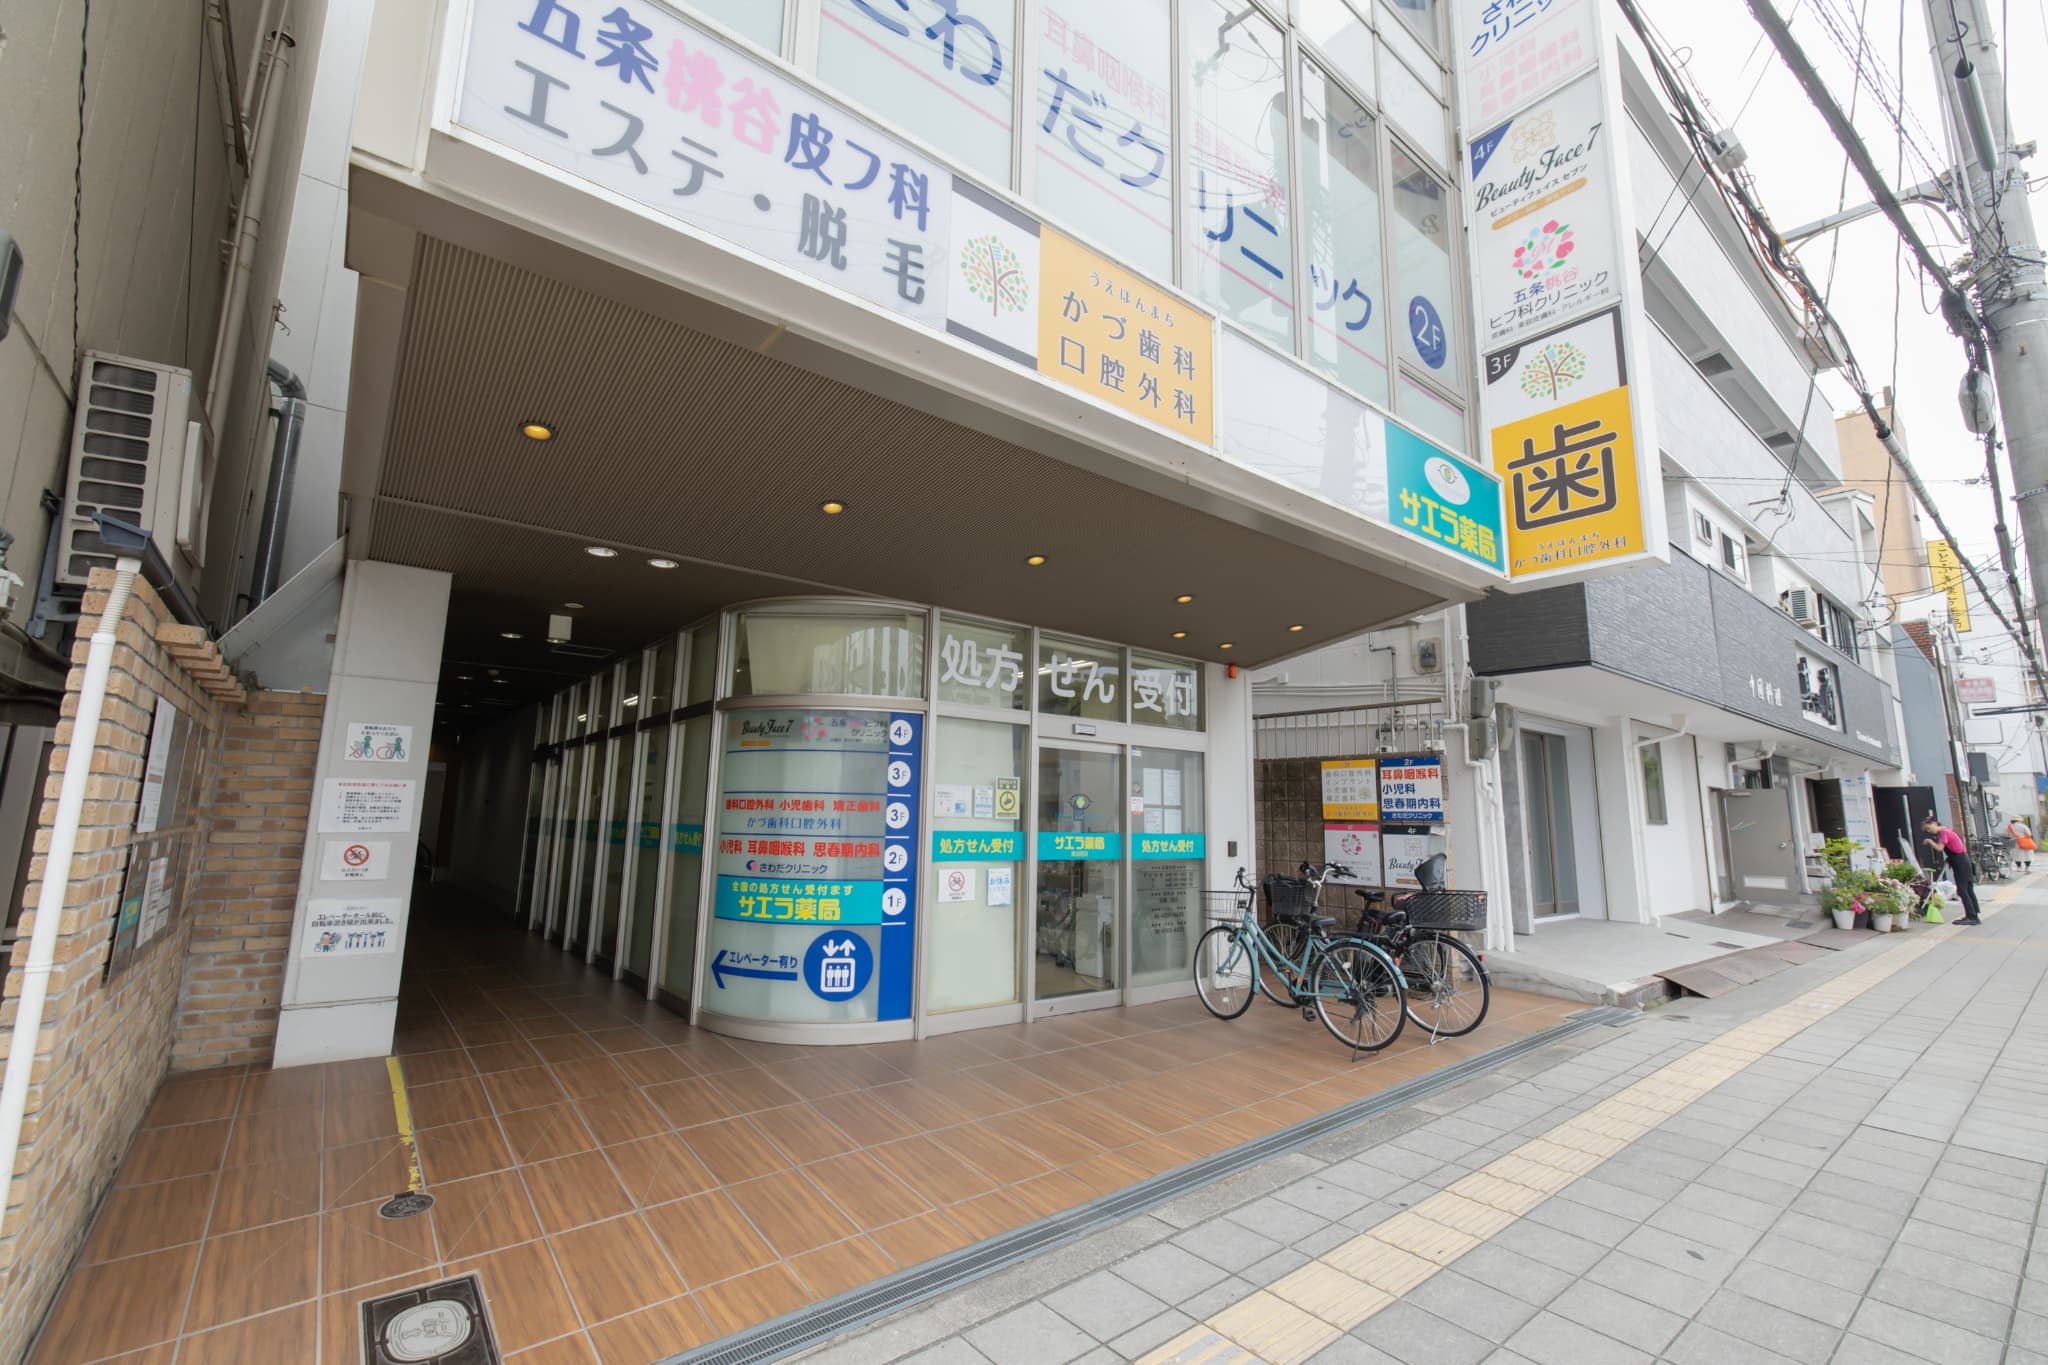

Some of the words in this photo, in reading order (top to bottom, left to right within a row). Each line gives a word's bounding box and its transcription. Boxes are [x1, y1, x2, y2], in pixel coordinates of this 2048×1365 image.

[1474, 141, 1494, 160] 4F
[1475, 166, 1536, 212] Beauty
[1535, 144, 1583, 180] Face
[1587, 122, 1602, 150] 7
[504, 60, 925, 305] エステ・脱毛
[1513, 266, 1578, 304] 五条桃谷
[1090, 272, 1175, 327] うえほんまち
[1490, 271, 1608, 329] ヒフ科クリニック
[1062, 291, 1196, 381] かづ歯科
[1414, 305, 1441, 353] 2F
[1490, 353, 1512, 375] 3F
[1060, 336, 1196, 424] 口腔外科
[1507, 420, 1617, 531] 歯
[1399, 487, 1497, 563] サエラ薬局
[940, 633, 1193, 716] 処方せん受付
[893, 726, 909, 739] 4F
[892, 767, 907, 781] 3F
[1382, 768, 1439, 780] 耳鼻咽喉科
[1382, 783, 1416, 795] 小児科
[779, 799, 825, 812] 小児歯科
[1383, 797, 1441, 809] 思春期内科
[890, 808, 905, 822] 3F
[747, 818, 841, 831] かづ歯科口腔外科
[720, 839, 743, 855] 小児科
[747, 840, 805, 857] 耳鼻咽喉科
[813, 842, 881, 859] 思春期内科
[940, 838, 1014, 854] 処方せん受付
[1142, 839, 1194, 854] 処方せん受付
[888, 851, 904, 865] 2F
[1389, 858, 1415, 871] Beauty
[759, 863, 828, 874] さわだクリニック
[732, 880, 854, 896] 全国の処方せん受付ます
[738, 896, 841, 921] サエラ薬局
[887, 895, 902, 909] 1F
[729, 951, 799, 969] エレベーター有り
